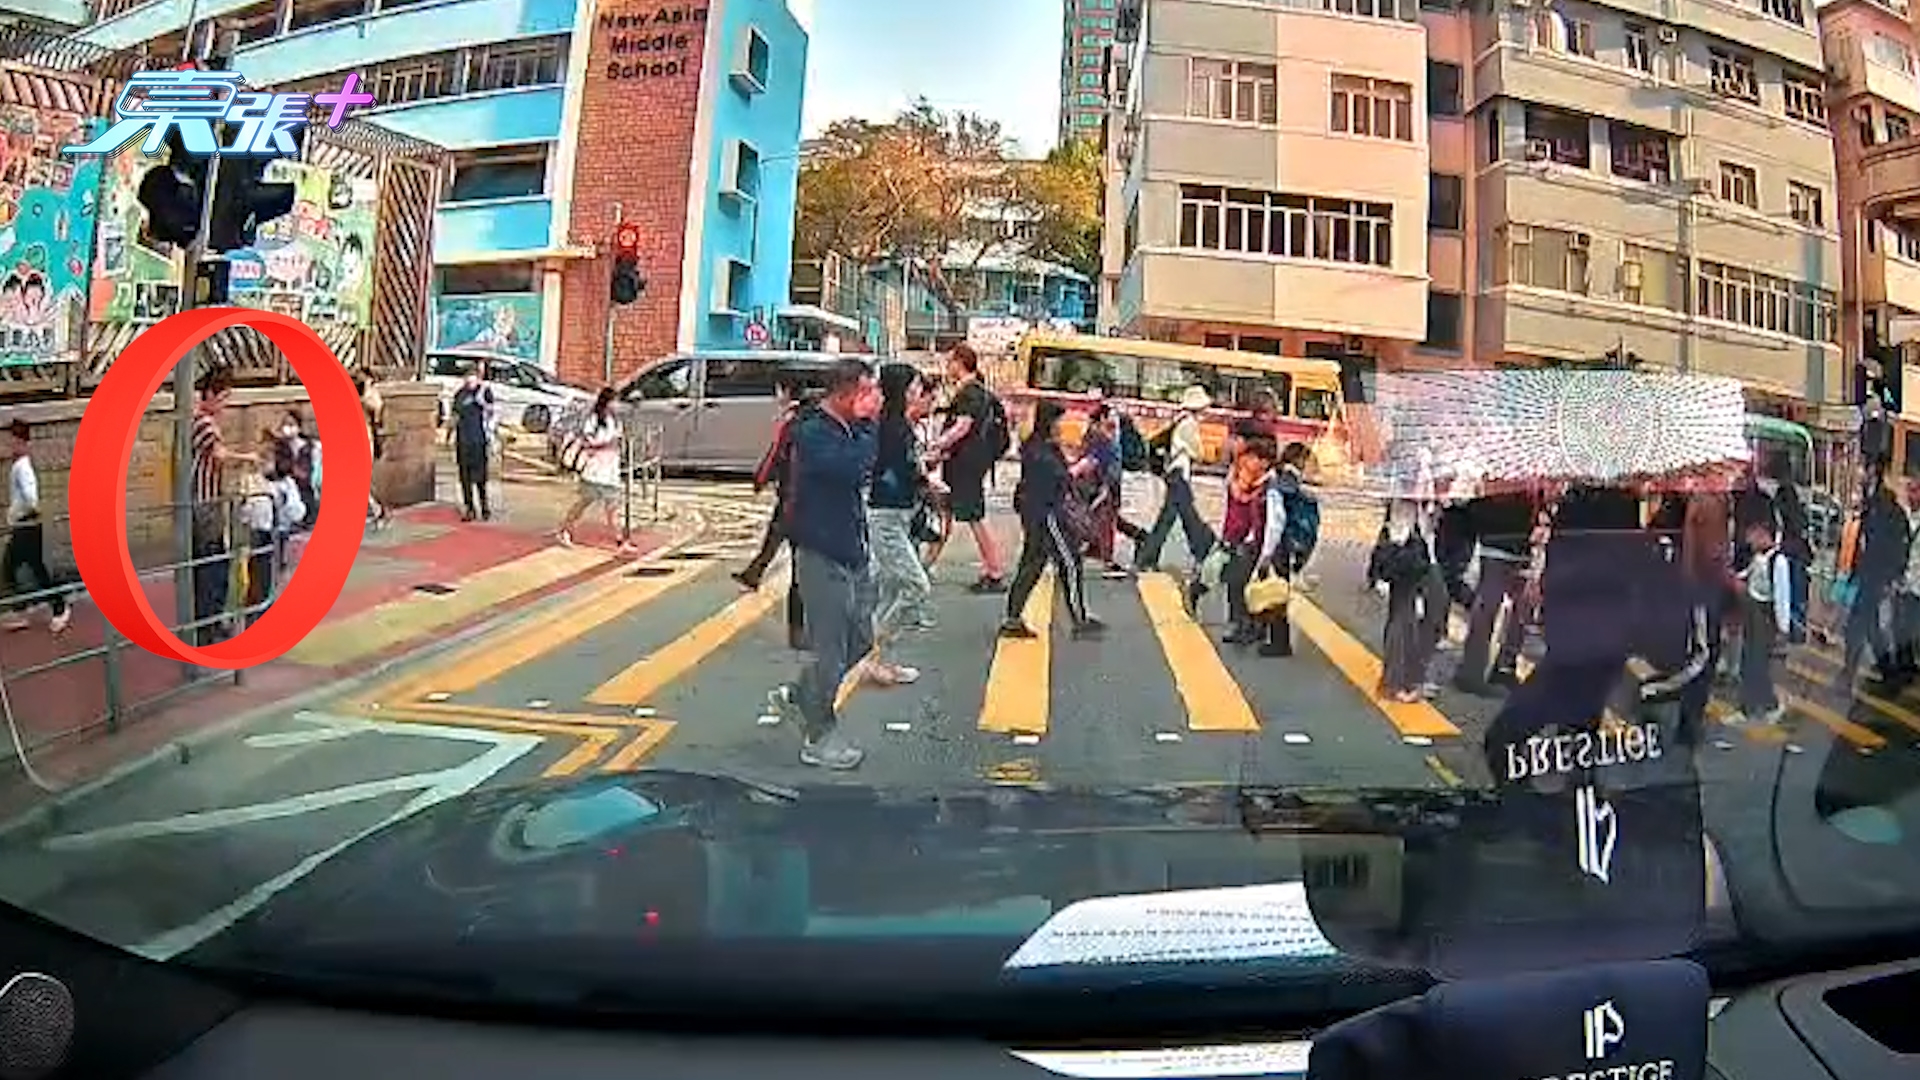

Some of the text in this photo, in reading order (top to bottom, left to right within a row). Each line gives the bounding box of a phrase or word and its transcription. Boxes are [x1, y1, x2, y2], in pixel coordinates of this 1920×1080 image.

[600, 13, 648, 28] New
[612, 34, 688, 53] Middle
[607, 58, 686, 79] School
